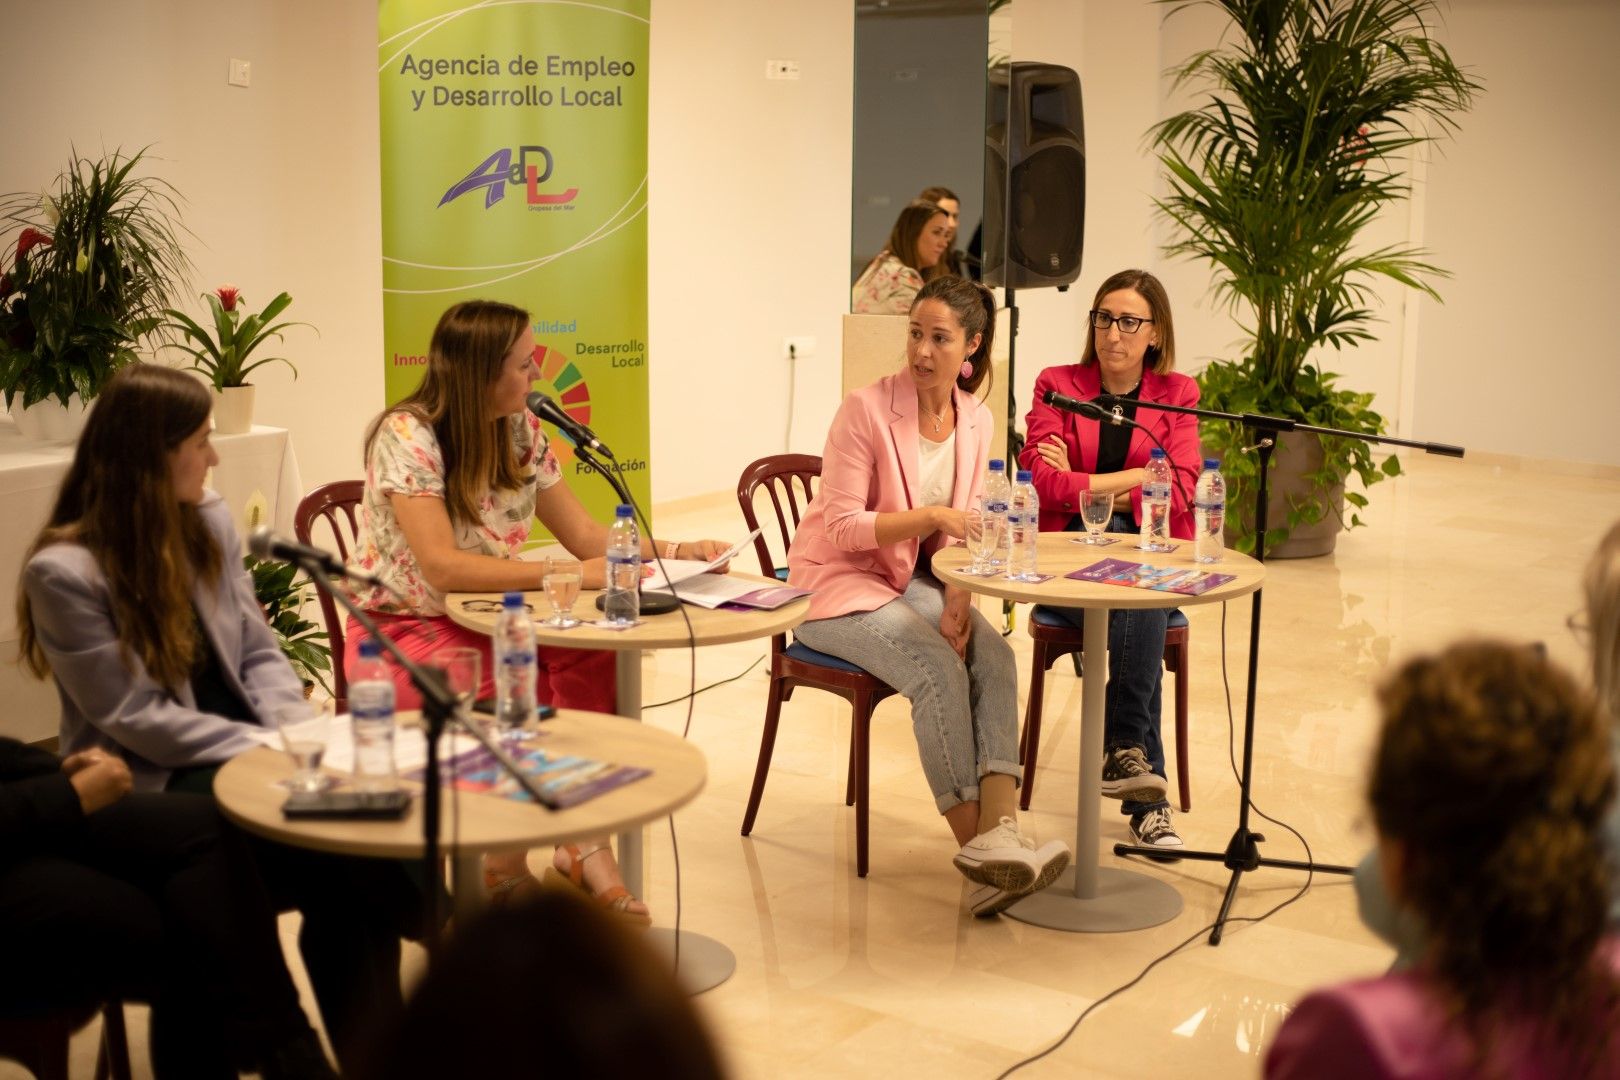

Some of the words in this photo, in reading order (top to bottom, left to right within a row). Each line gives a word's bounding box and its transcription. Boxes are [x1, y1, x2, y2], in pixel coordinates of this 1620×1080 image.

[400, 54, 500, 80] Agencia
[508, 55, 538, 76] de
[546, 56, 635, 81] Empleo
[411, 90, 425, 111] y
[433, 86, 553, 106] Desarrollo
[561, 86, 622, 107] Local
[575, 340, 645, 355] Desarrollo
[394, 352, 428, 367] Inno
[611, 353, 644, 368] Local
